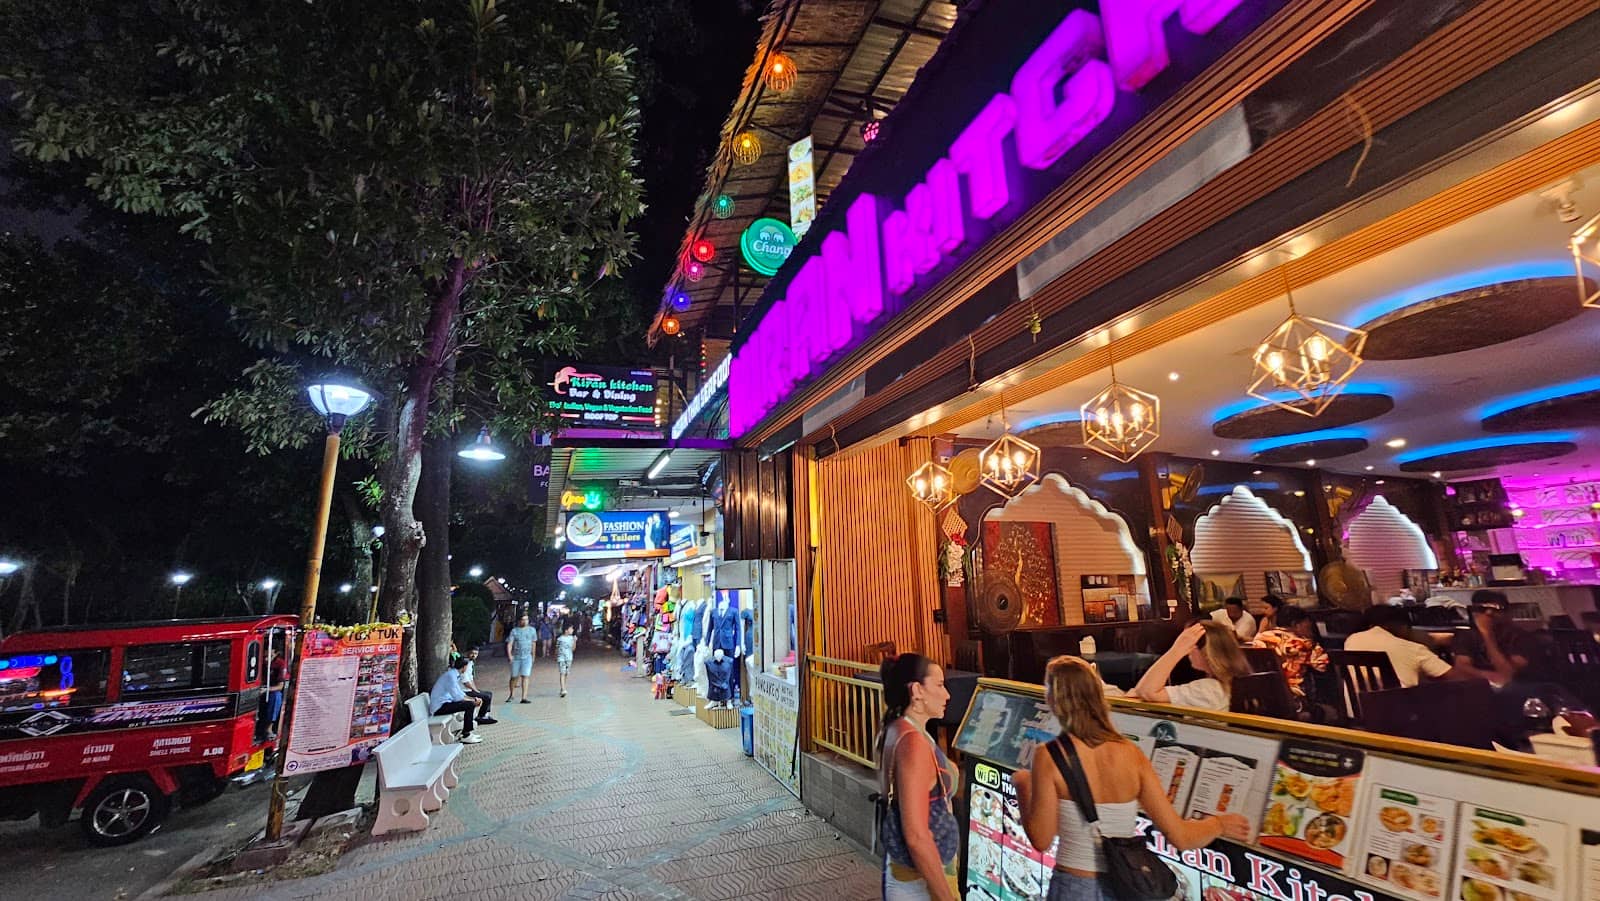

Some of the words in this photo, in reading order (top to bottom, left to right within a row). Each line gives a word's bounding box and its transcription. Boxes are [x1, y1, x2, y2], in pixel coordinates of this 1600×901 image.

[753, 240, 793, 258] Chang
[570, 377, 607, 389] Kiran
[609, 379, 654, 392] kitchen
[569, 388, 590, 398] Bar
[603, 390, 637, 402] Dining
[603, 521, 645, 531] FASHION
[611, 533, 641, 542] Tailors
[377, 628, 399, 640] TUK
[342, 645, 375, 655] SERVICE
[377, 644, 397, 652] CLUB
